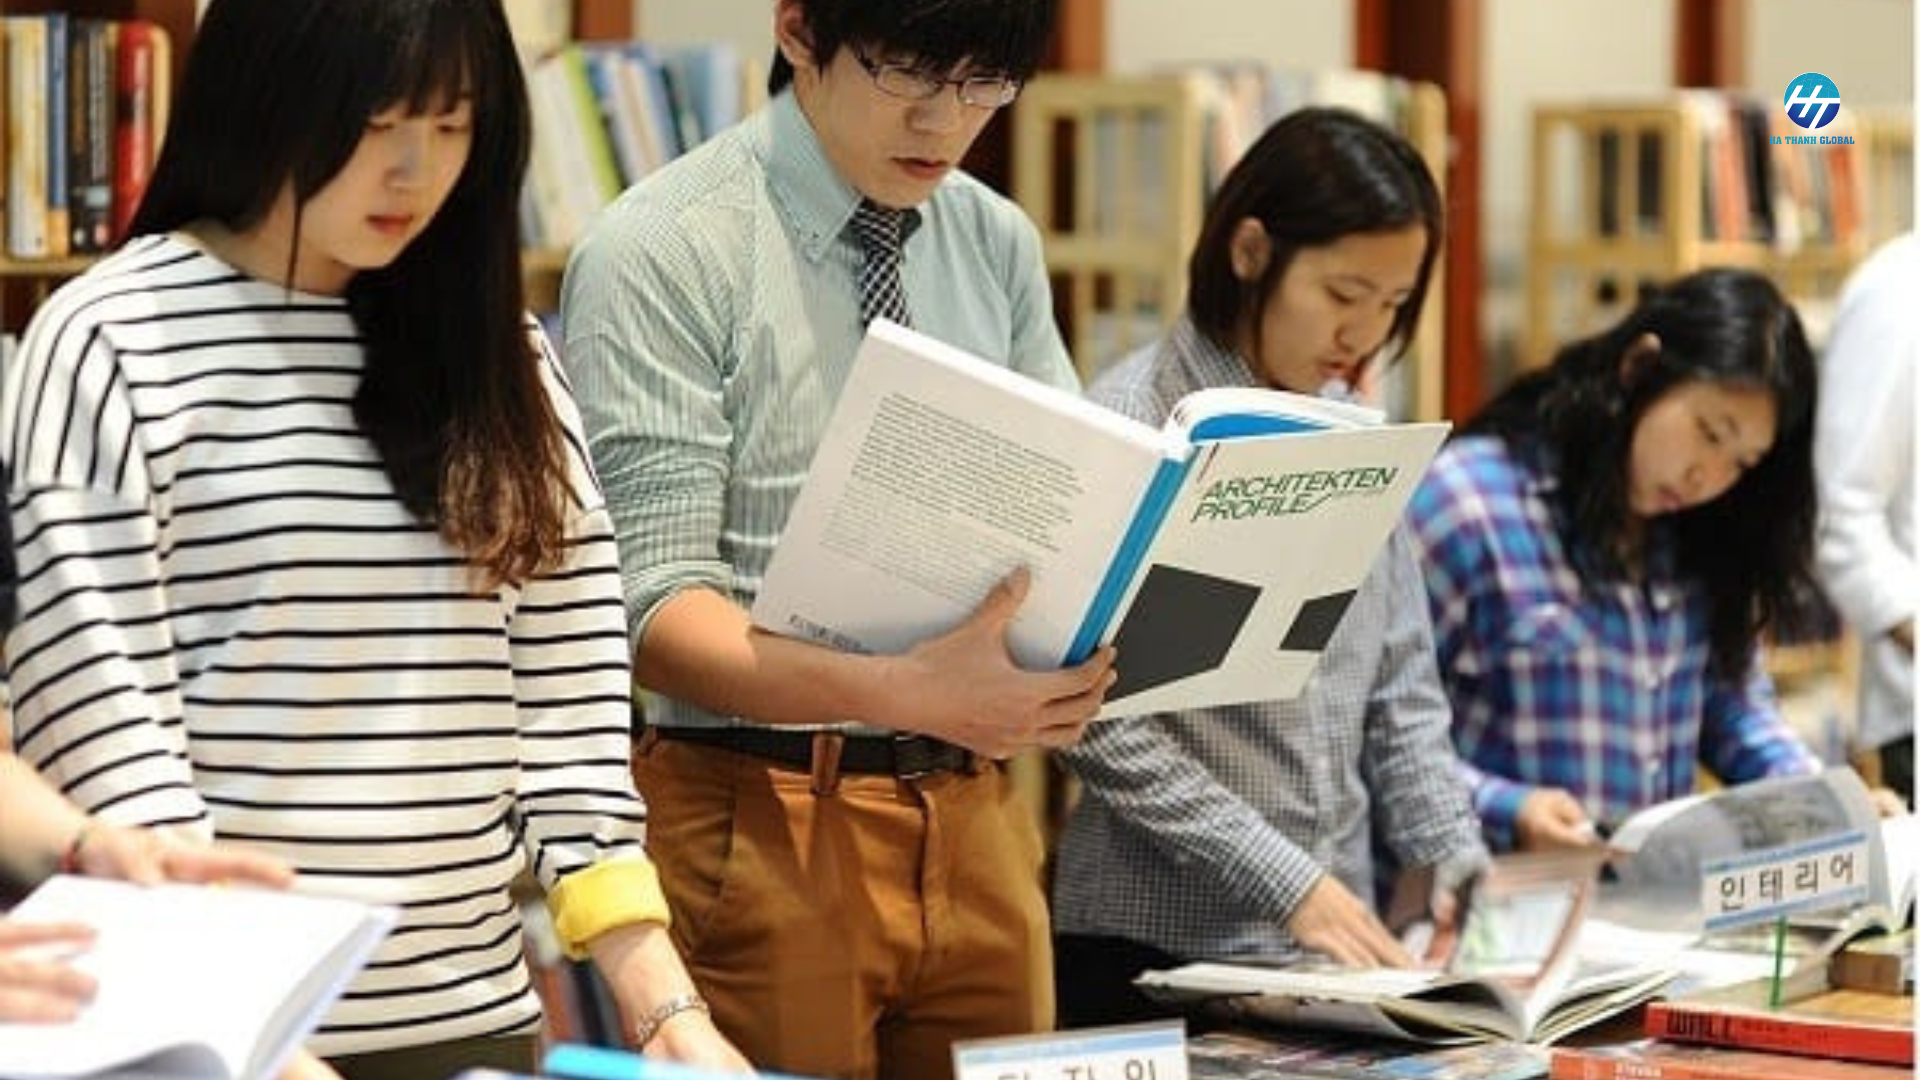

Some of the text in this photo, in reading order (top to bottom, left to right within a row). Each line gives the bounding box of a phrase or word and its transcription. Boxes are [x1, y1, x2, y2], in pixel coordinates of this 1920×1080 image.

[1202, 466, 1399, 500] ARCHITEKTEN
[1190, 493, 1318, 523] PROFILE
[1720, 851, 1854, 913] 인테리어
